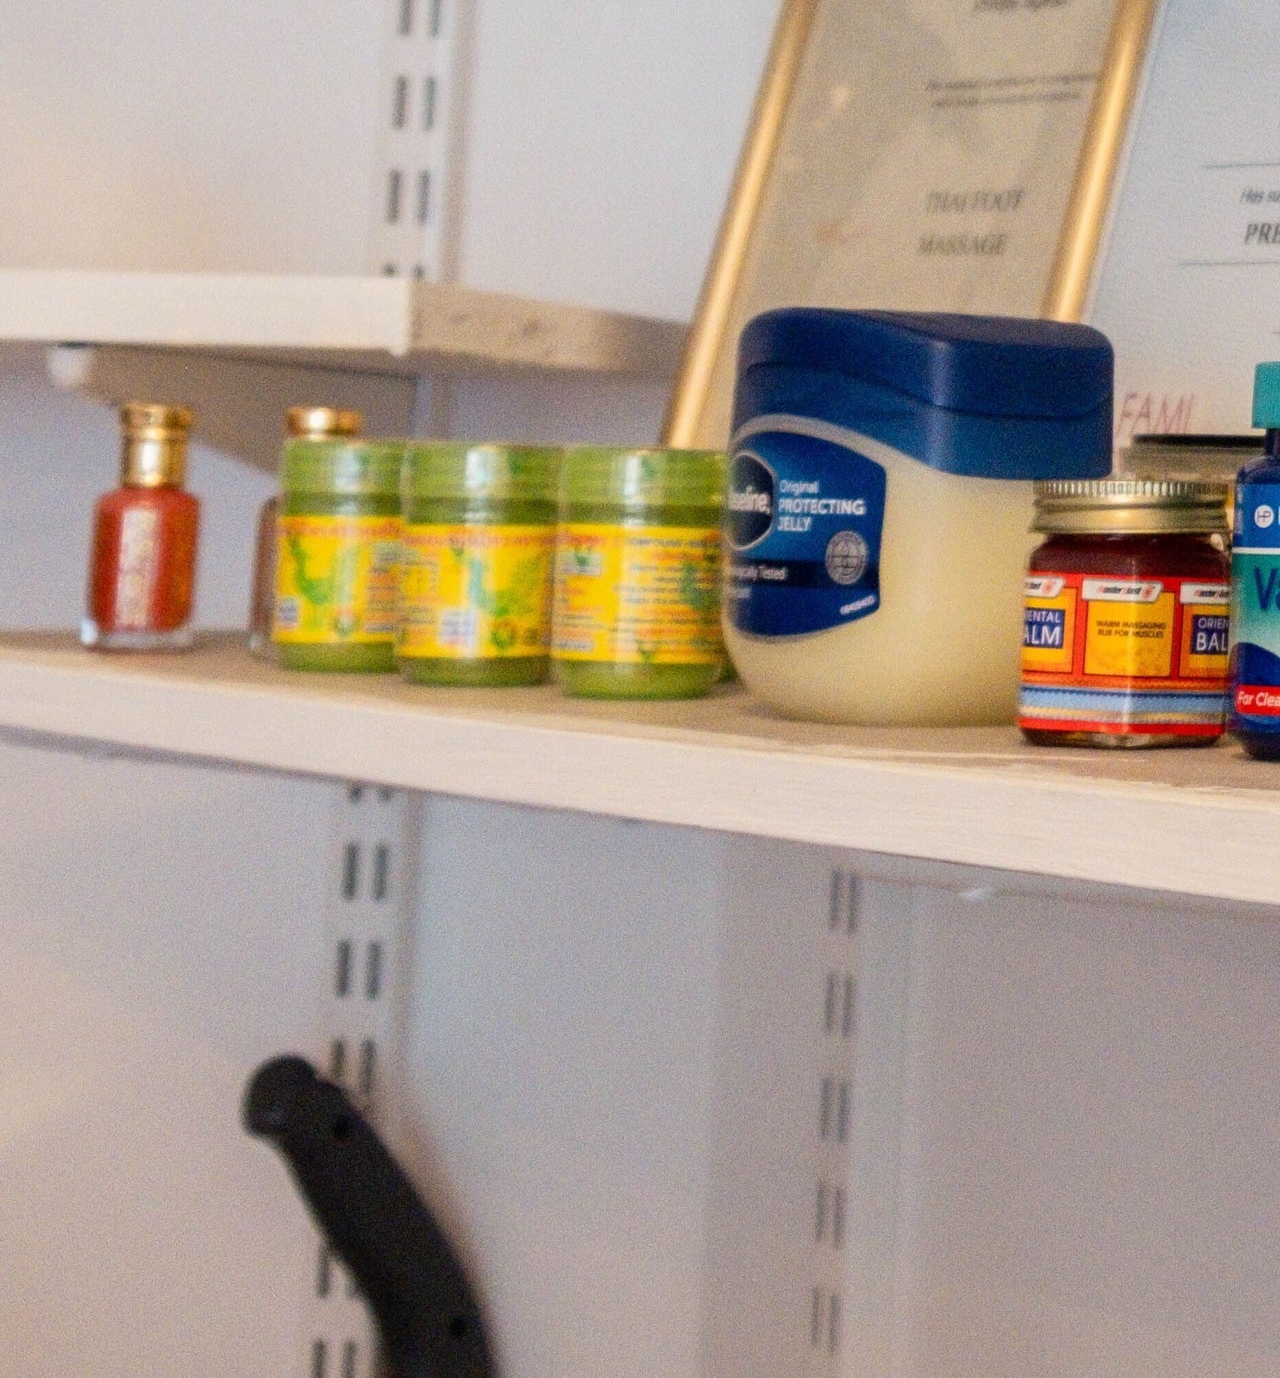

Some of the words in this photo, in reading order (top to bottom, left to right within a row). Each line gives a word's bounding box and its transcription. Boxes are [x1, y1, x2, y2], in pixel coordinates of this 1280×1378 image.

[779, 480, 819, 496] Original
[778, 497, 867, 515] PROTECTING
[777, 516, 812, 532] JELLY
[1237, 690, 1253, 705] For
